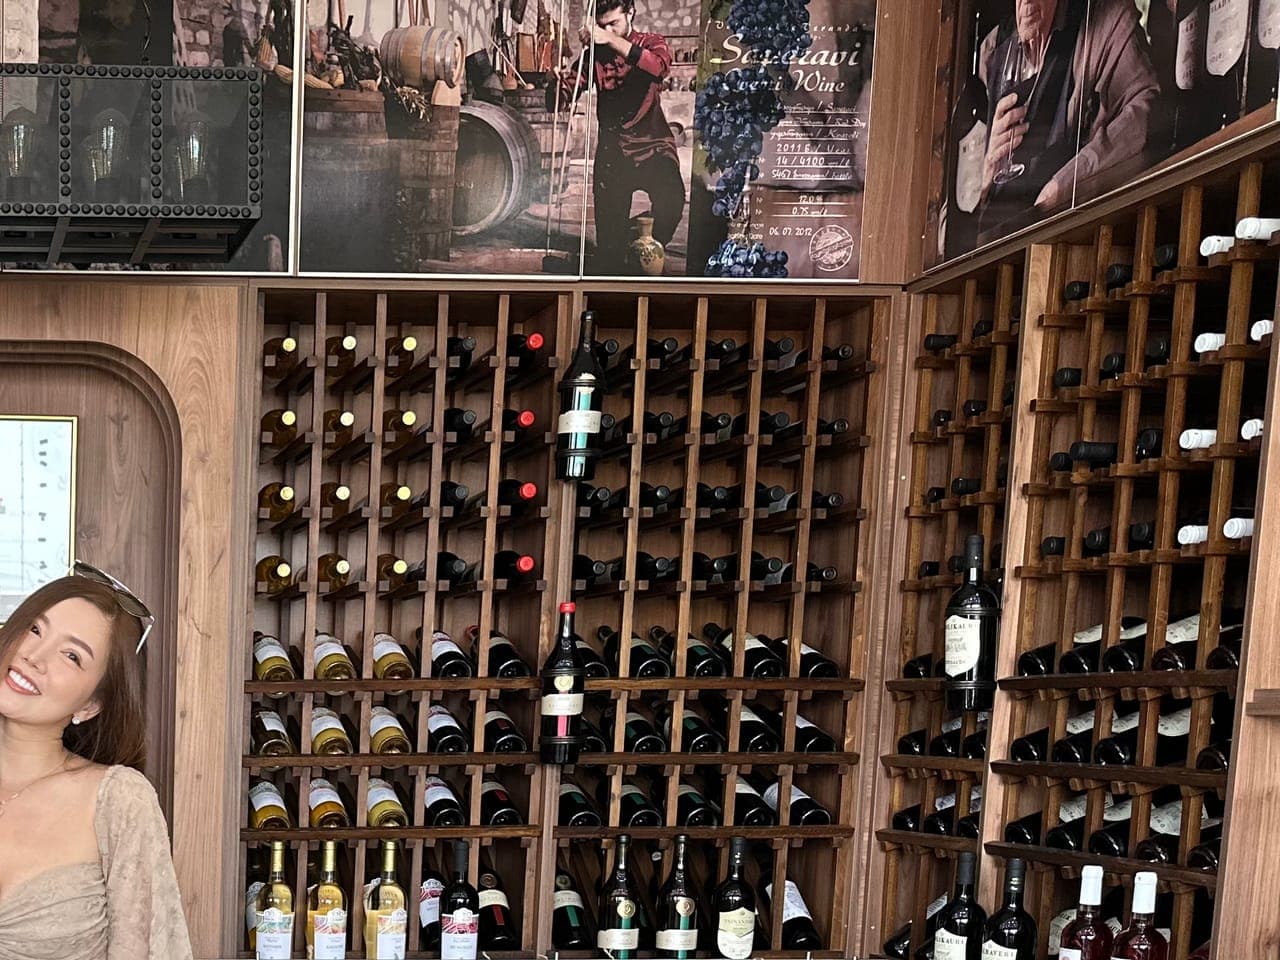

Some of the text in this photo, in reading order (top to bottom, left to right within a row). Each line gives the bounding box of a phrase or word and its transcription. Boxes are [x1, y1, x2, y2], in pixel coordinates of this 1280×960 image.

[791, 70, 845, 92] Wine
[776, 143, 801, 152] 2011
[795, 227, 813, 236] 2012
